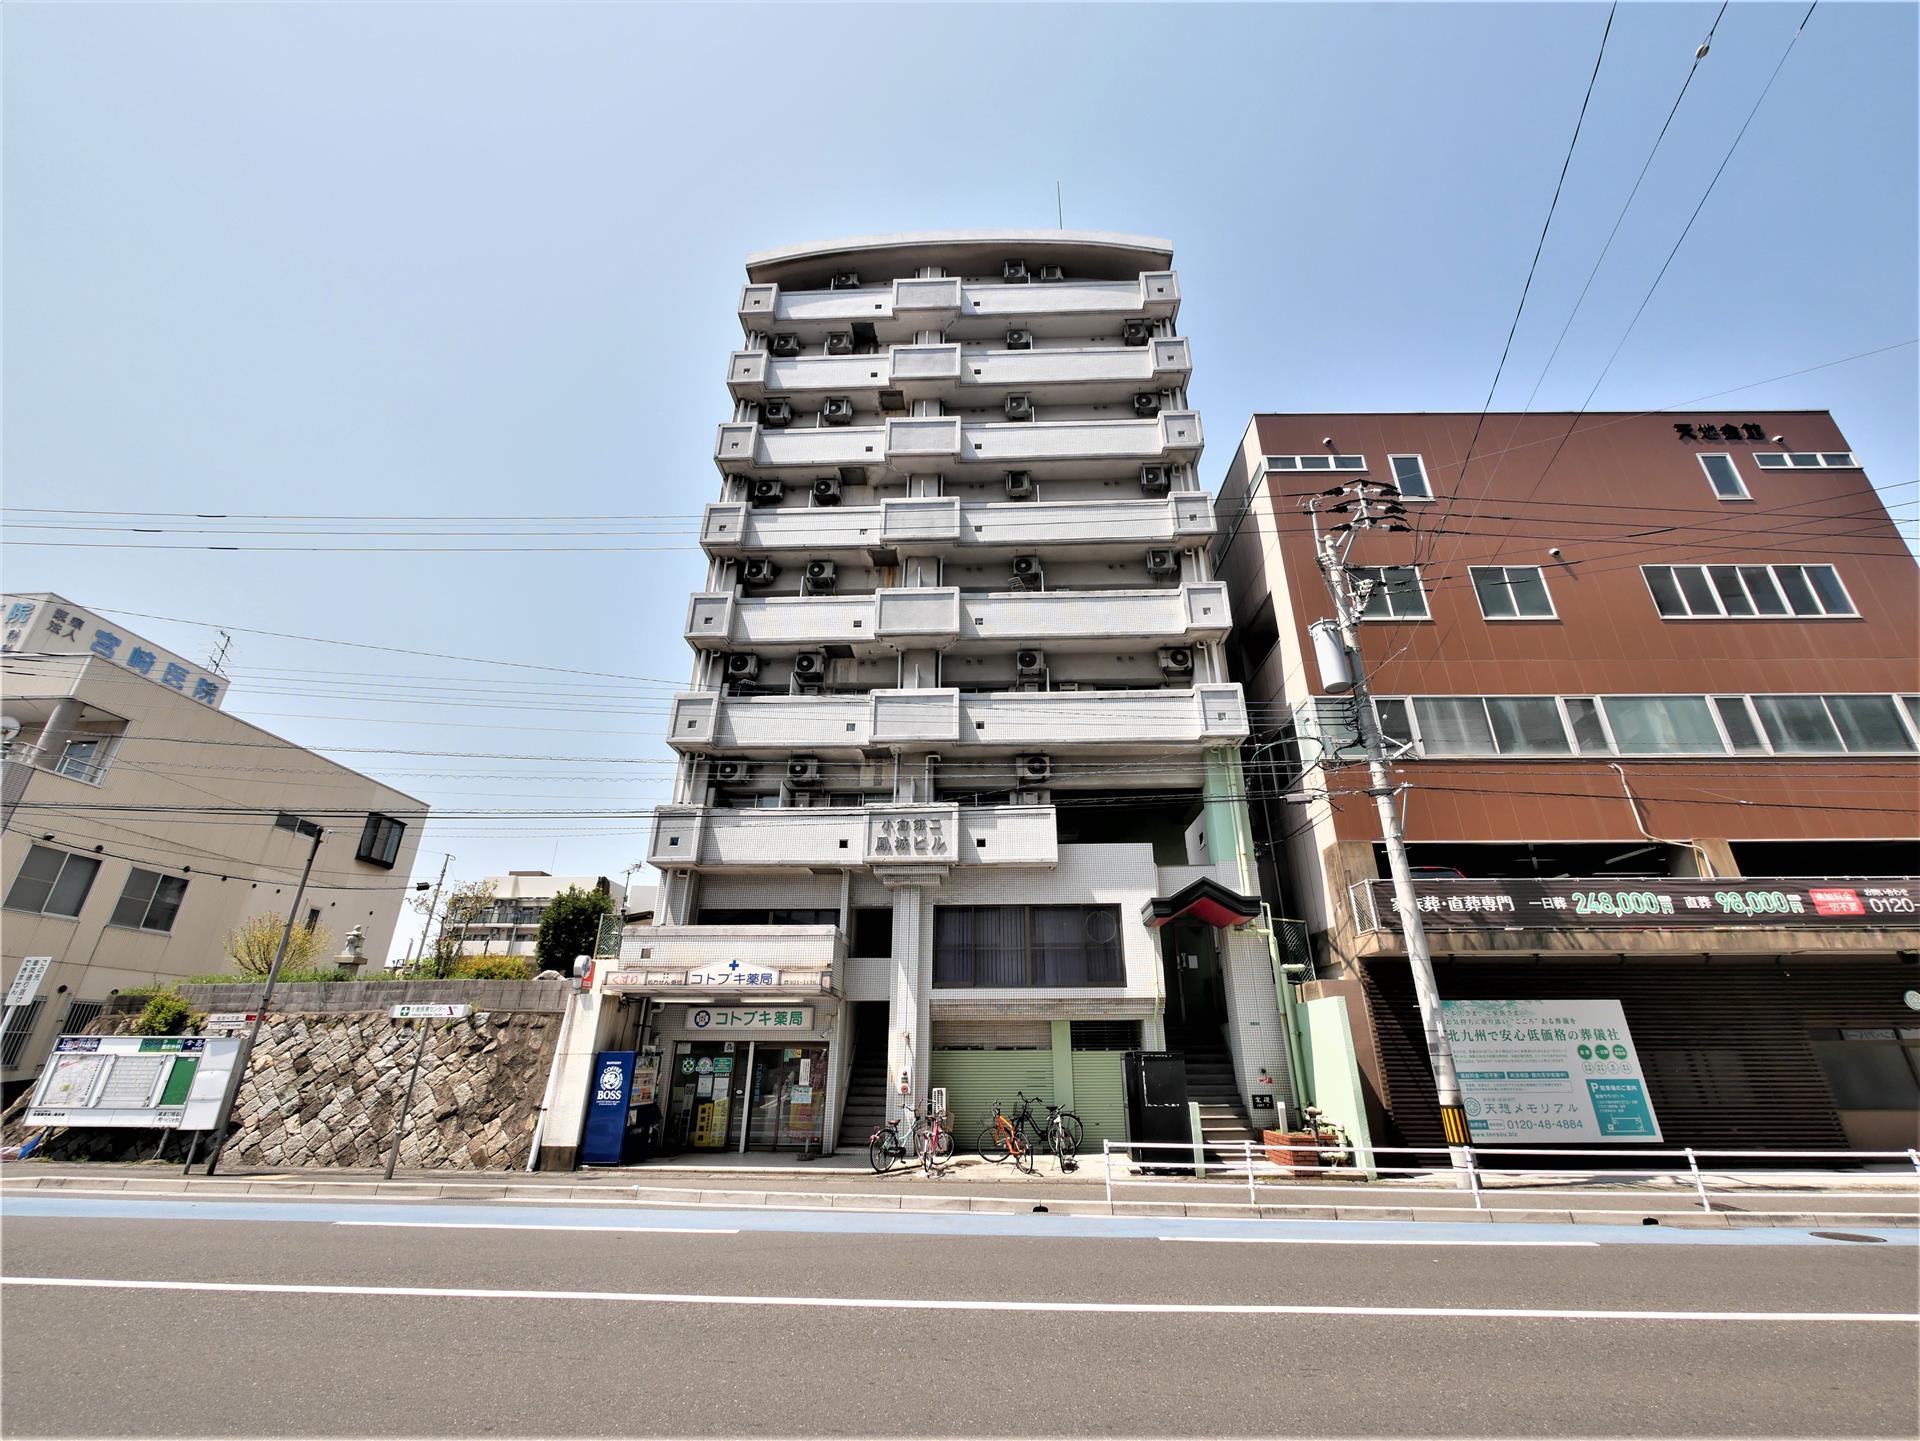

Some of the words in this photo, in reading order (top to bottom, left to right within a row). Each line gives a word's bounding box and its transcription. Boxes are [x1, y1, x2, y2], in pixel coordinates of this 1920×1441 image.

[1529, 897, 1568, 910] 一日葬
[1683, 895, 1712, 909] 直葬
[612, 974, 639, 985] くすり
[690, 972, 773, 985] コトブキ薬局
[715, 1010, 803, 1026] コトブキ薬局
[596, 1090, 622, 1100] BOSS
[1507, 1120, 1584, 1130] 0120-48-4884
